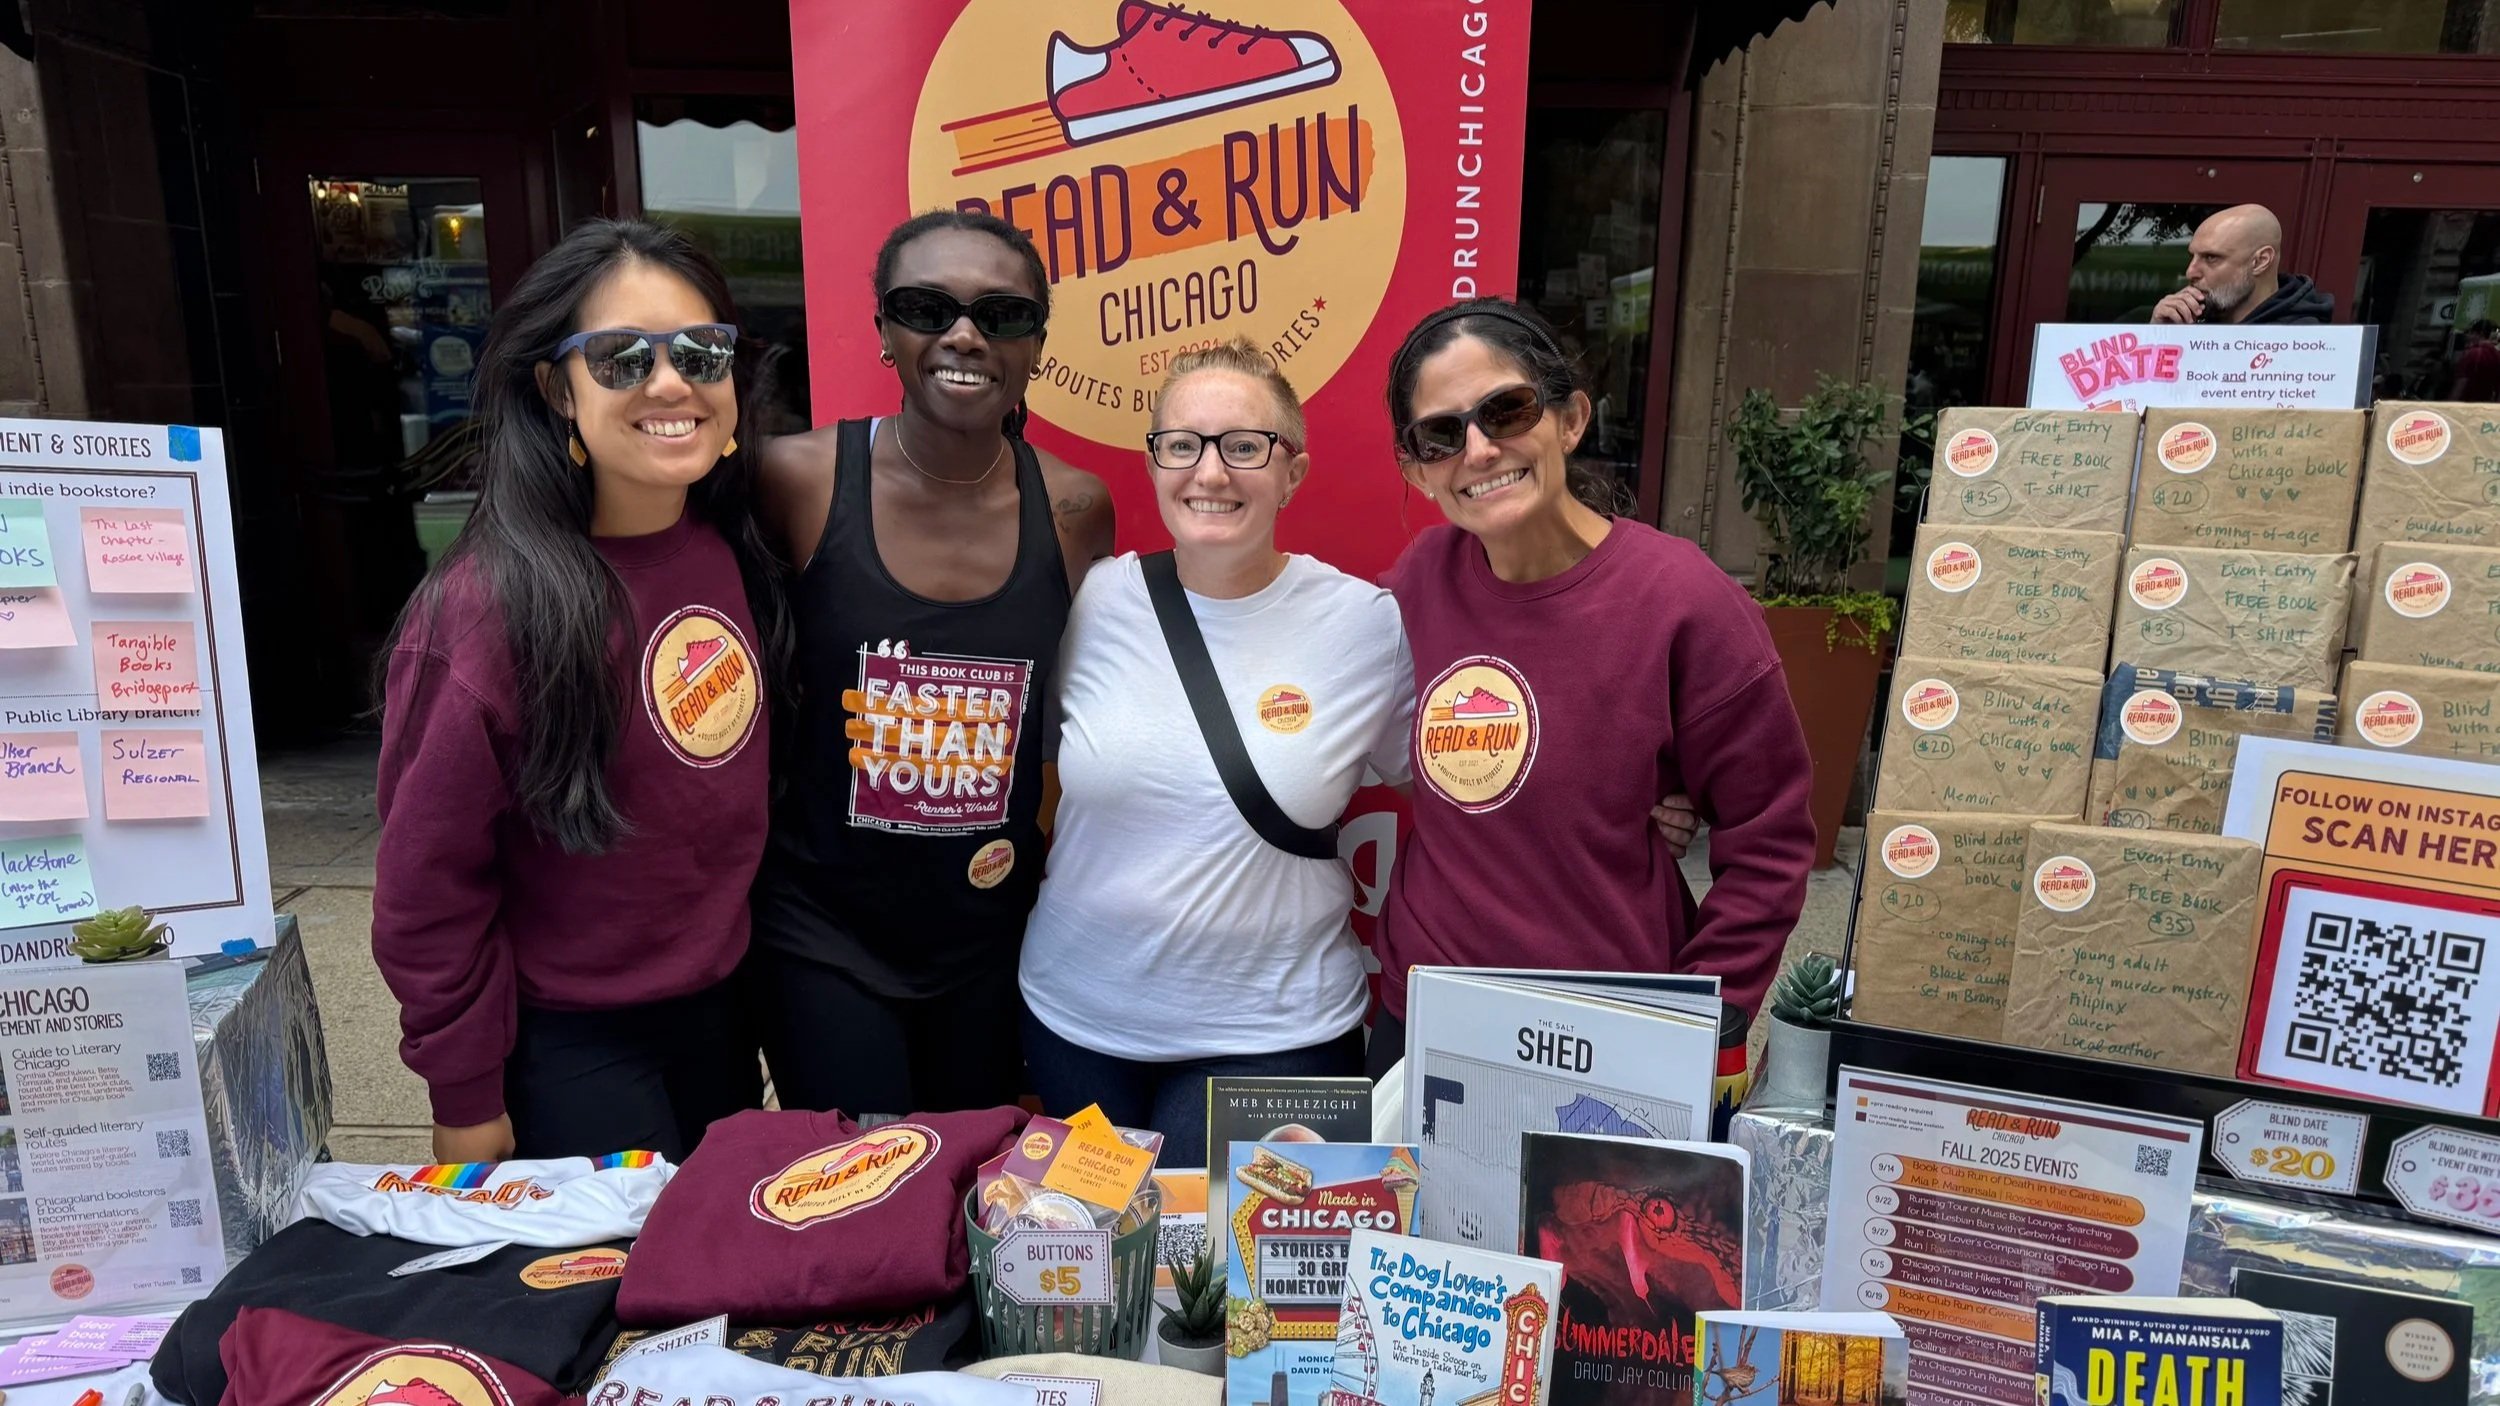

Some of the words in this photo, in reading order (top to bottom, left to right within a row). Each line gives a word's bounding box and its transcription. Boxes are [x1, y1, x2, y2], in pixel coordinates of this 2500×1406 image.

[957, 165, 1133, 285] EAD
[1152, 168, 1202, 236] &
[1224, 104, 1360, 256] RUN
[1101, 259, 1258, 347] CHICAGO
[2059, 333, 2139, 374] BLIND
[2190, 340, 2218, 351] With
[2223, 343, 2230, 351] a
[2234, 340, 2289, 354] Chicago
[2292, 340, 2336, 351] book...
[1042, 357, 1123, 408] ROUTES
[2072, 345, 2184, 400] DATE
[2186, 371, 2218, 382] Book
[2222, 371, 2247, 383] and
[2251, 371, 2303, 385] running
[2307, 372, 2336, 382] tour
[2201, 389, 2235, 399] event
[2241, 388, 2275, 402] entry
[2279, 388, 2316, 399] ticket
[2013, 417, 2060, 433] Event
[2067, 419, 2112, 443] Entry
[2232, 426, 2276, 441] Blind
[51, 434, 64, 454] &
[73, 435, 152, 458] STORIES
[2020, 452, 2062, 466] FREE
[2073, 452, 2112, 470] BOOK
[2228, 463, 2294, 485] Chicago
[2304, 460, 2349, 477] book
[8, 482, 54, 496] indie
[59, 483, 156, 499] bookstore?
[2007, 584, 2042, 597] FREE
[2052, 584, 2089, 601] BOOK
[107, 634, 177, 660] Tangible
[119, 658, 172, 673] Books
[899, 664, 928, 675] THIS
[931, 667, 966, 679] BOOK
[970, 669, 1001, 682] CLUB
[1004, 671, 1015, 682] IS
[111, 681, 200, 705] Bridgeport
[671, 684, 708, 736] READ
[715, 649, 745, 693] RUN
[866, 677, 1013, 720] FASTER
[1983, 691, 2023, 709] Blind
[6, 710, 63, 725] Public
[68, 708, 129, 723] Library
[865, 713, 1007, 763] THAN
[1425, 728, 1462, 760] READ
[1466, 732, 1478, 747] &
[1482, 723, 1520, 757] RUN
[1979, 733, 2041, 760] Chicago
[5, 757, 75, 778] Branch
[863, 756, 1003, 799] YOURS
[965, 801, 998, 813] World
[1944, 787, 2000, 806] Memoir
[2280, 786, 2373, 813] FOLLOW
[2378, 800, 2411, 819] ON
[856, 816, 892, 830] CHICAGO
[1954, 834, 1986, 847] Blind
[2302, 816, 2408, 856] SCAN
[2123, 847, 2176, 866] Event
[2181, 853, 2225, 874] Entry
[1965, 872, 2005, 886] book
[2128, 883, 2172, 905] FREE
[2182, 893, 2224, 914] BOOK
[1929, 966, 1967, 981] Black
[2123, 957, 2169, 972] adult
[2111, 977, 2166, 995] murder
[46, 1018, 72, 1033] AND
[74, 1013, 124, 1032] STORIES
[1538, 1018, 1553, 1029] THE
[1555, 1022, 1575, 1033] SALT
[12, 1046, 53, 1060] Guide
[56, 1046, 70, 1057] to
[72, 1043, 122, 1057] Literary
[1517, 1026, 1593, 1074] SHED
[14, 1058, 71, 1071] Chicago
[1229, 1098, 1258, 1108] MEB
[1266, 1098, 1357, 1110] KEFLEZIGHI
[23, 1122, 98, 1140] Self-guided
[100, 1120, 145, 1134] literary
[1966, 1108, 2008, 1132] READ
[2010, 1118, 2021, 1130] &
[2024, 1118, 2060, 1141] RUN
[2269, 1113, 2301, 1126] BLIND
[2304, 1118, 2329, 1131] DATE
[25, 1138, 68, 1150] routes
[2263, 1128, 2289, 1142] WITH
[2302, 1135, 2329, 1148] BOOK
[1078, 1142, 1104, 1157] READ
[1113, 1155, 1135, 1168] RUN
[1941, 1140, 1977, 1162] FALL
[1980, 1147, 2021, 1170] 2025
[2024, 1155, 2079, 1180] EVENTS
[2428, 1140, 2456, 1154] BLIND
[2457, 1147, 2479, 1159] DATE
[1078, 1156, 1121, 1177] CHICAGO
[2250, 1146, 2335, 1180] $20
[2437, 1157, 2465, 1171] EVENT
[775, 1172, 841, 1208] READ
[1878, 1162, 1894, 1172] 9/14
[1912, 1161, 1938, 1172] Book
[1941, 1165, 1965, 1178] Club
[1967, 1171, 1989, 1183] Run
[1991, 1175, 2001, 1185] of
[2004, 1177, 2034, 1193] Death
[2038, 1182, 2047, 1193] in
[2050, 1184, 2067, 1198] the
[2069, 1188, 2100, 1203] Cards
[35, 1192, 105, 1208] Chicagoland
[106, 1187, 167, 1200] bookstores
[1318, 1190, 1358, 1207] Made
[1361, 1191, 1377, 1206] in
[39, 1207, 140, 1224] recommendations
[1261, 1207, 1396, 1230] CHICAGO
[1875, 1195, 1892, 1206] 9/22
[1909, 1194, 1946, 1209] Running
[1948, 1200, 1968, 1212] Tour
[1970, 1204, 1980, 1214] of
[1981, 1209, 2008, 1220] Music
[2009, 1212, 2026, 1223] Box
[2028, 1214, 2065, 1231] Lounge:
[2067, 1223, 2112, 1242] Searching
[1027, 1244, 1094, 1261] BUTTONS
[1270, 1241, 1335, 1258] STORIES
[1040, 1266, 1082, 1296] $5
[1370, 1247, 1398, 1275] The
[1401, 1252, 1441, 1289] Dog
[1443, 1258, 1507, 1304] Lover's
[1370, 1275, 1501, 1322] Companion
[79, 1321, 116, 1330] dear
[1382, 1301, 1400, 1327] to
[1402, 1306, 1491, 1353] Chicago
[2072, 1315, 2141, 1328] AWARD-WINNING
[2143, 1322, 2177, 1330] AUTHOR
[69, 1330, 109, 1340] book
[2092, 1327, 2123, 1341] MIA
[2150, 1333, 2251, 1350] MANANSALA
[1392, 1350, 1419, 1366] Where
[1431, 1359, 1452, 1374] Take
[1393, 1339, 1407, 1353] The
[1412, 1344, 1440, 1360] Inside
[1443, 1351, 1469, 1370] Scoop
[1291, 1367, 1320, 1375] DAVID
[1574, 1360, 1613, 1383] DAVID
[1618, 1366, 1644, 1386] JAY
[2086, 1348, 2245, 1406] DEATH
